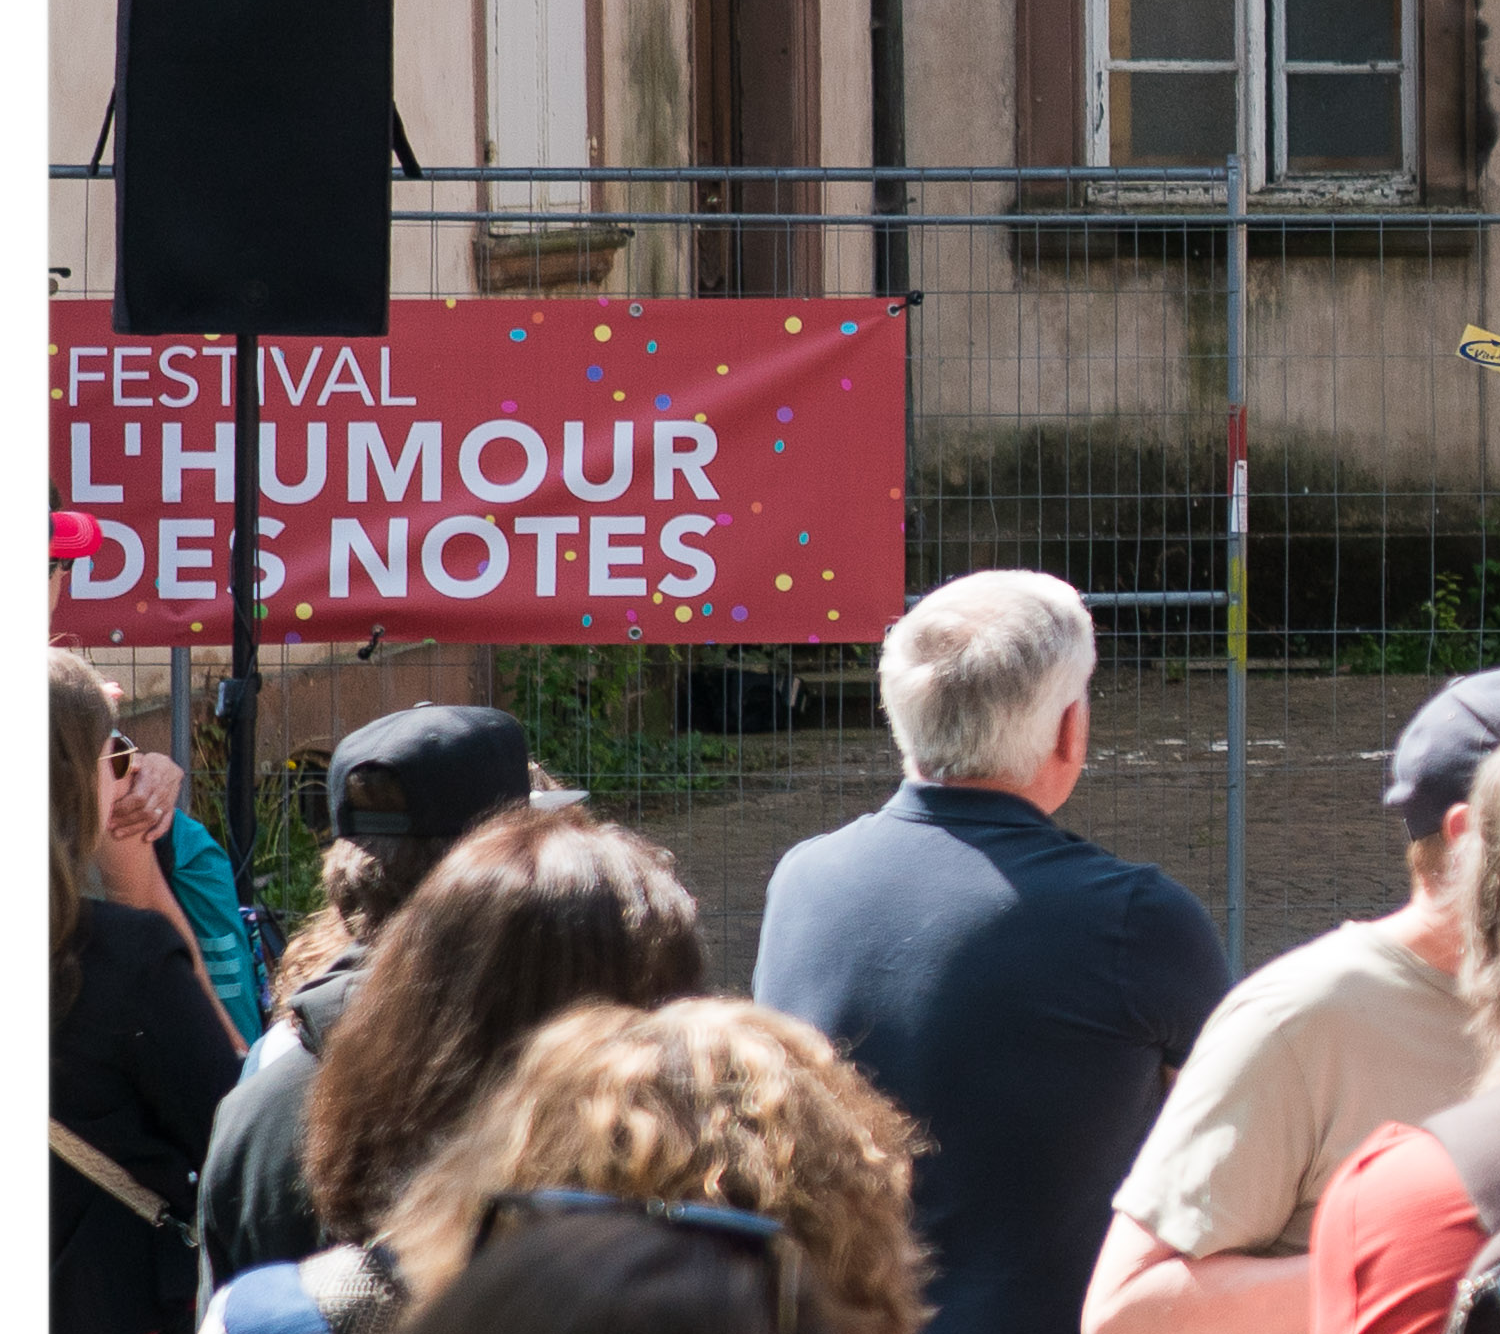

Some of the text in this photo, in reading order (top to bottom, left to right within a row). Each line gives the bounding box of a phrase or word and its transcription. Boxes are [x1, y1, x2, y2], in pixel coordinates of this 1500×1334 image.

[67, 345, 417, 408] FESTIVAL
[70, 420, 720, 504] L'HUMOUR
[70, 514, 717, 600] DES NOTES
